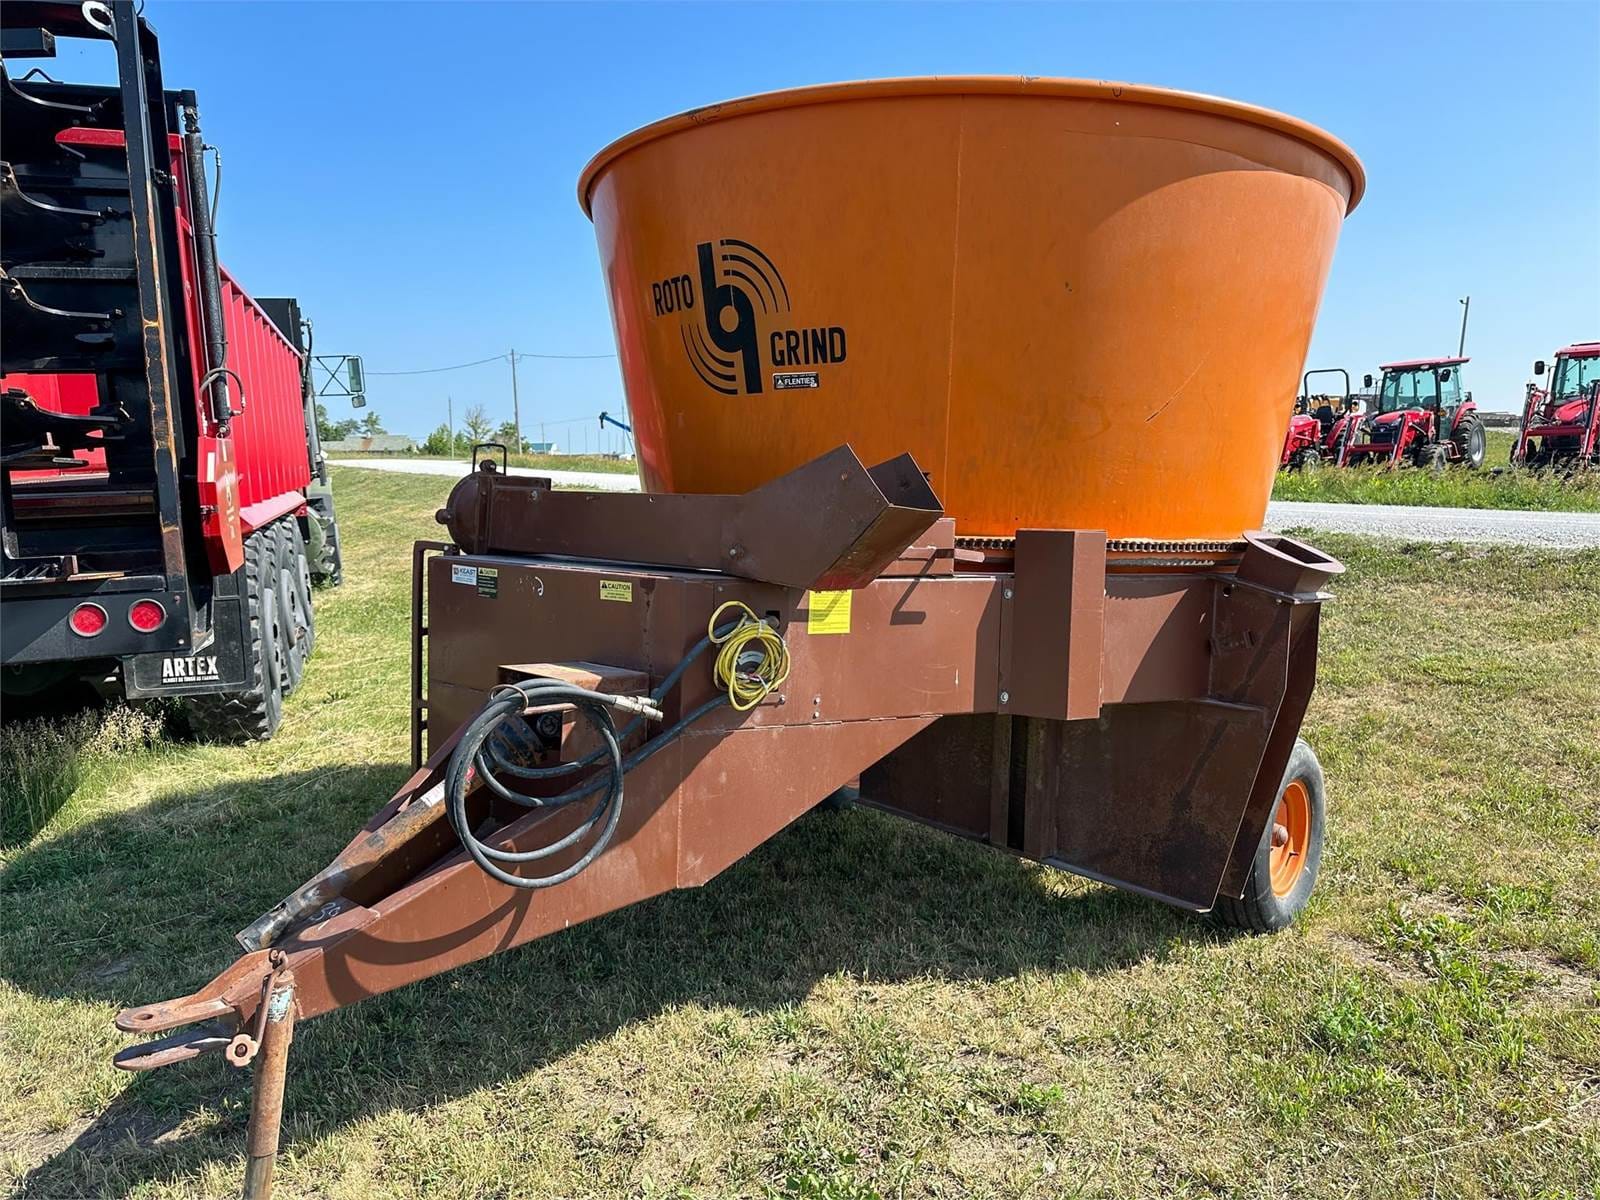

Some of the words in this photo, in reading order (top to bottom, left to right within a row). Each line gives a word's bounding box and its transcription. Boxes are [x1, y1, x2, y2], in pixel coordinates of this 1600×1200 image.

[652, 274, 695, 316] ROTO
[770, 326, 847, 366] GRIND
[607, 582, 631, 590] CAUTION
[162, 656, 219, 678] ARTEX
